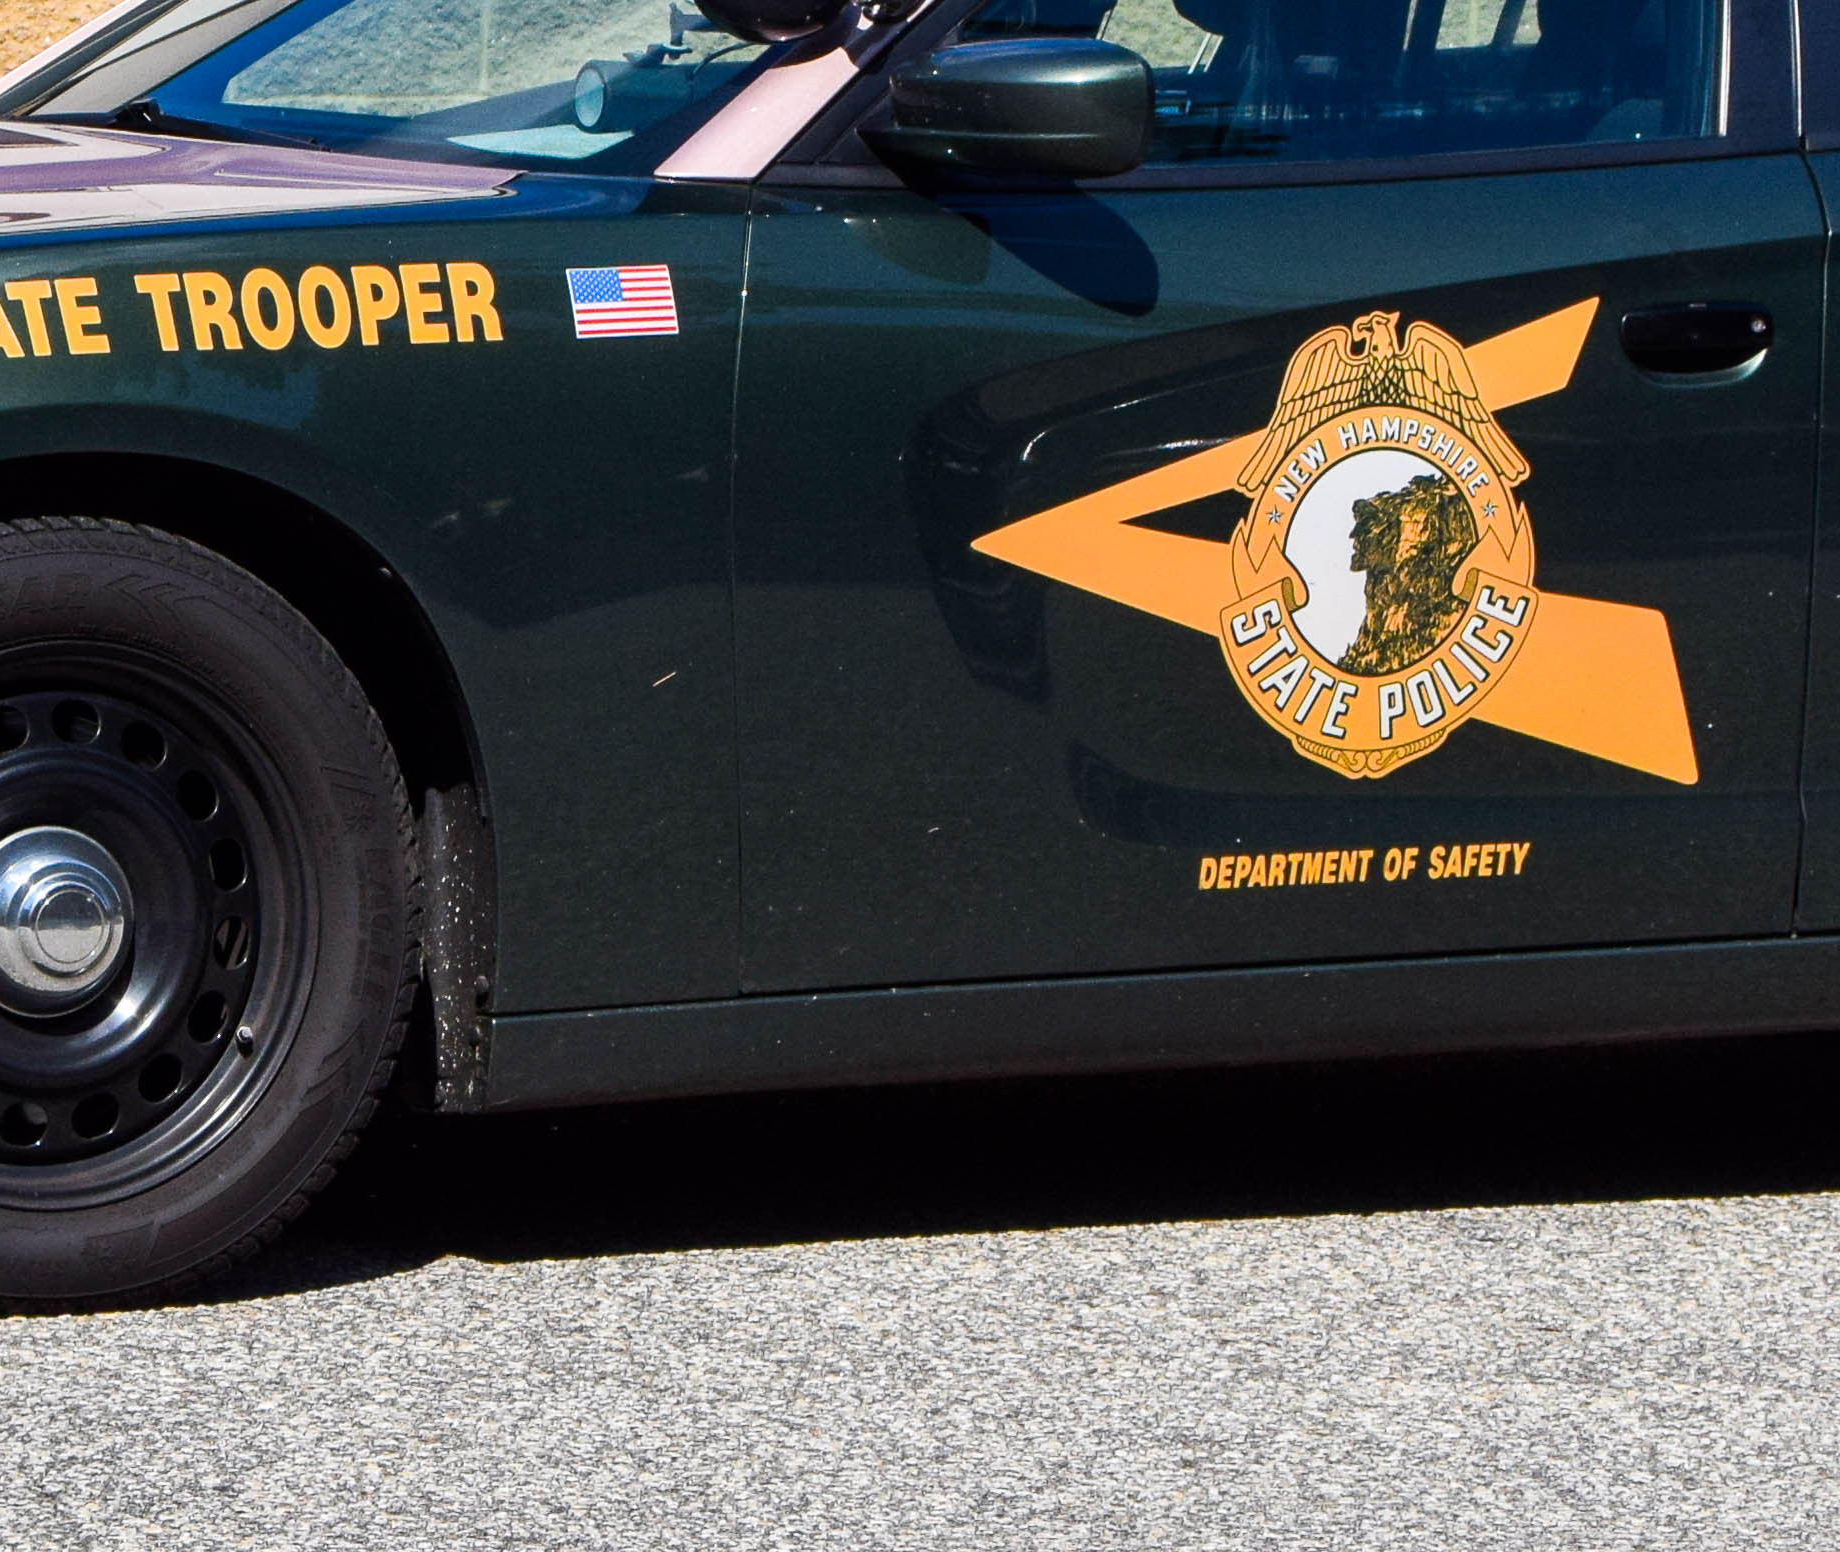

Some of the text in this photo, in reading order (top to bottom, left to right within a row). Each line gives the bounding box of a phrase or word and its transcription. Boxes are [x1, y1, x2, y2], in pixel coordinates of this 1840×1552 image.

[134, 261, 503, 352] TROOPER
[1273, 415, 1490, 503] NEW HAMPSHIRE
[1231, 584, 1530, 739] STATE POLICE
[1198, 842, 1531, 890] DEPARTMENT OF SAFETY
